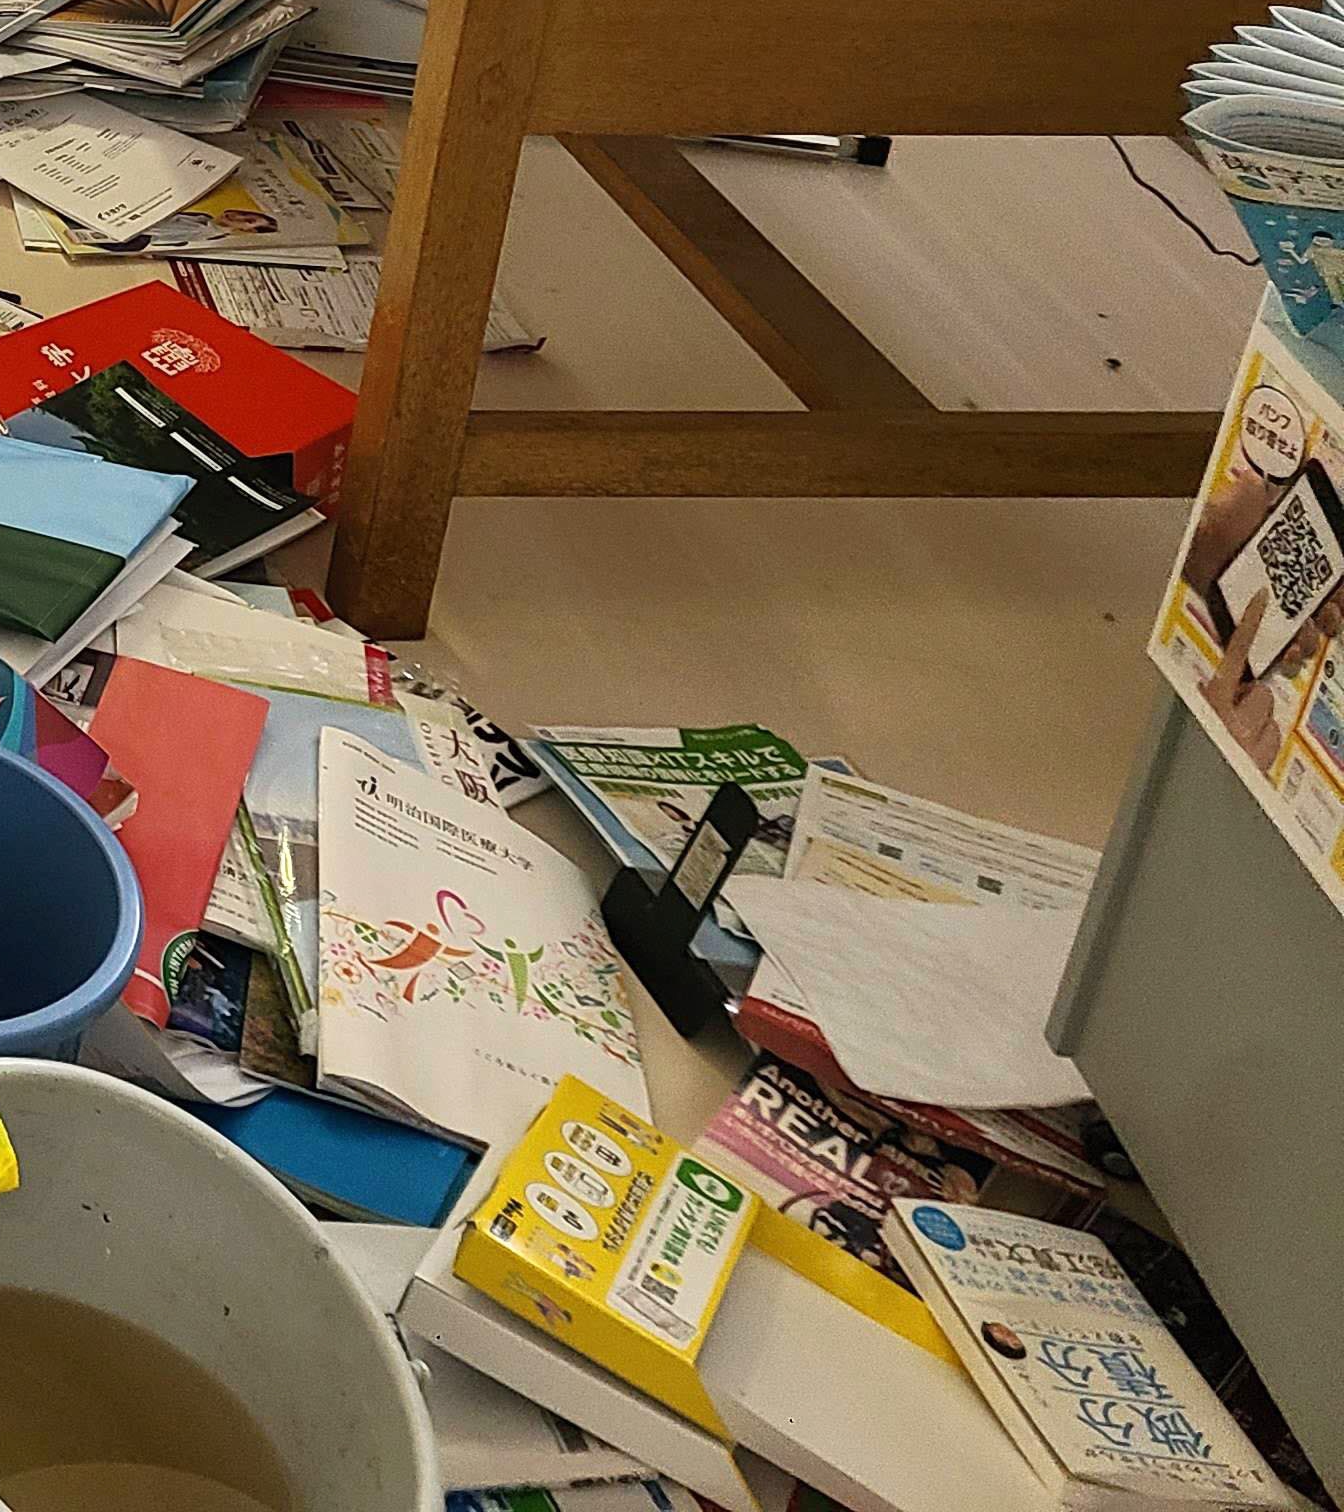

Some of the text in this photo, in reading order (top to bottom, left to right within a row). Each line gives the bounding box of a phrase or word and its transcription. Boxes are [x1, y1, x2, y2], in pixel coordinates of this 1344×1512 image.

[439, 729, 499, 809] 大阪
[385, 790, 535, 874] 明治国際医療大学
[739, 1084, 878, 1195] REAL
[757, 1061, 870, 1146] Another
[1041, 1335, 1170, 1406] 積分
[1077, 1393, 1211, 1461] 微分
